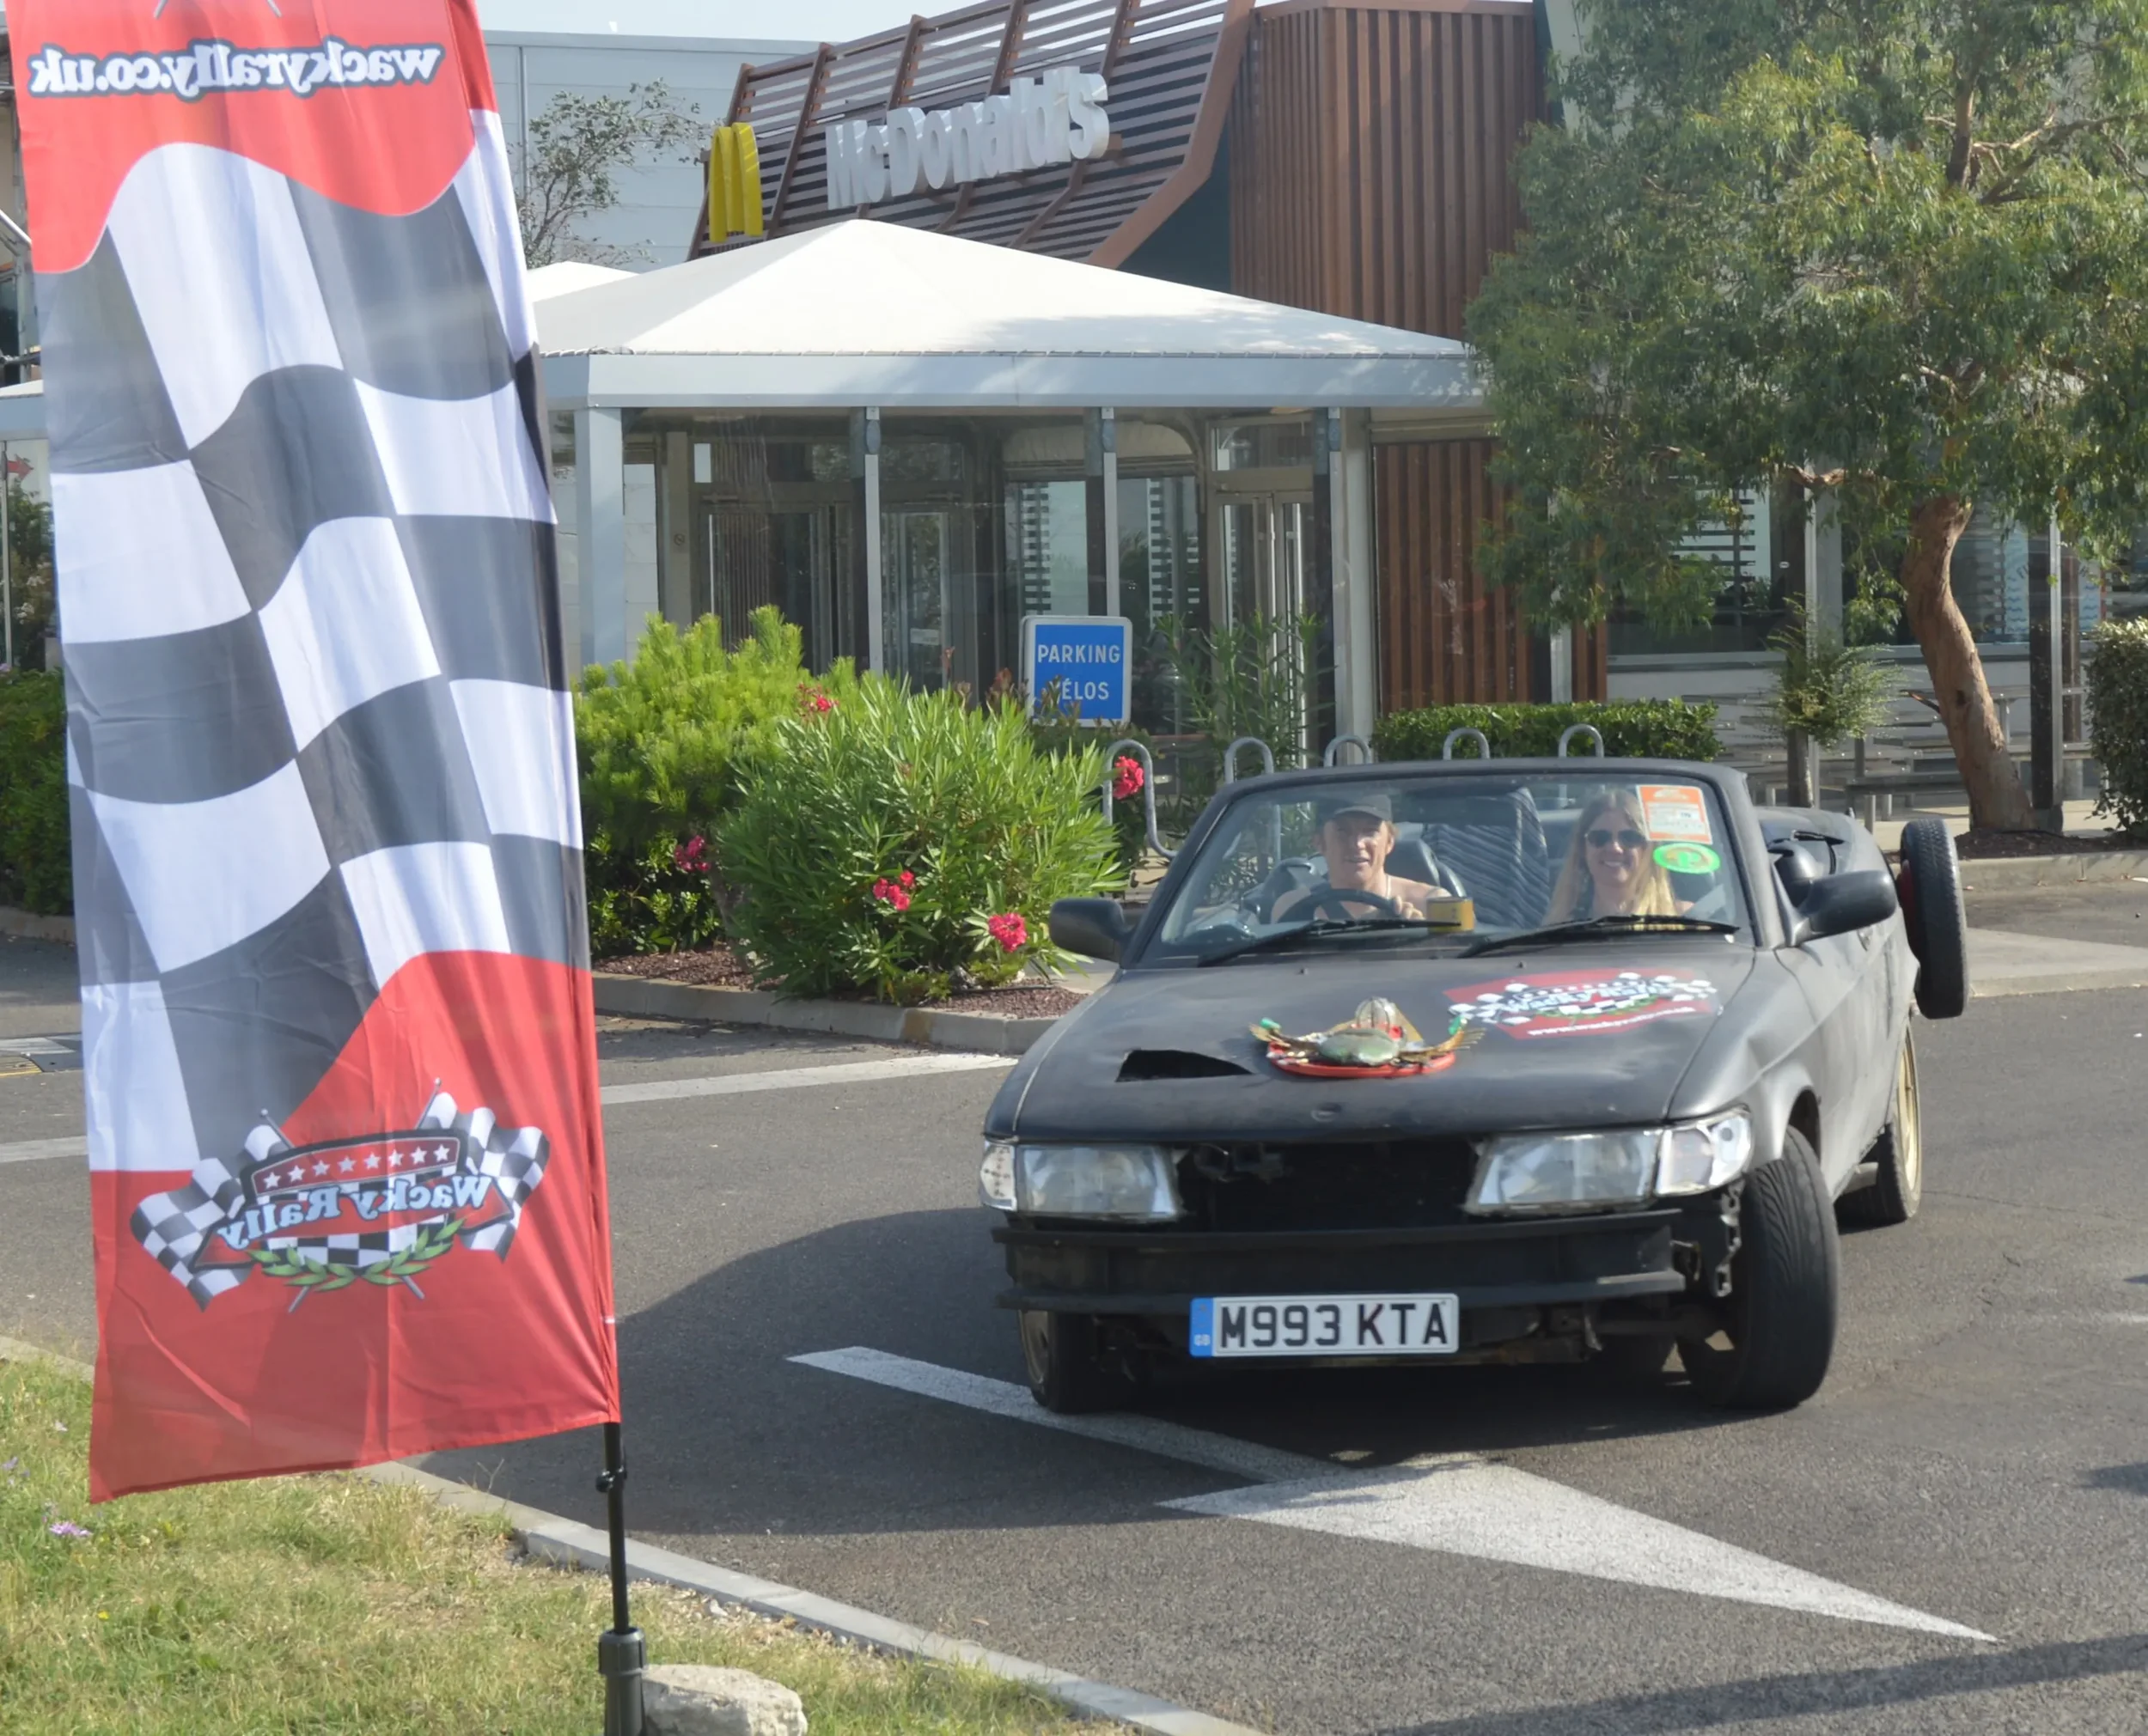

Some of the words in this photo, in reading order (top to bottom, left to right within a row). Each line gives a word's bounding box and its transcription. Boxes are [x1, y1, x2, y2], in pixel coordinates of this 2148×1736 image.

[825, 65, 1110, 210] McDonald's
[1037, 644, 1120, 663] PARKING
[1220, 1304, 1340, 1348] M993
[1357, 1302, 1449, 1345] KTA
